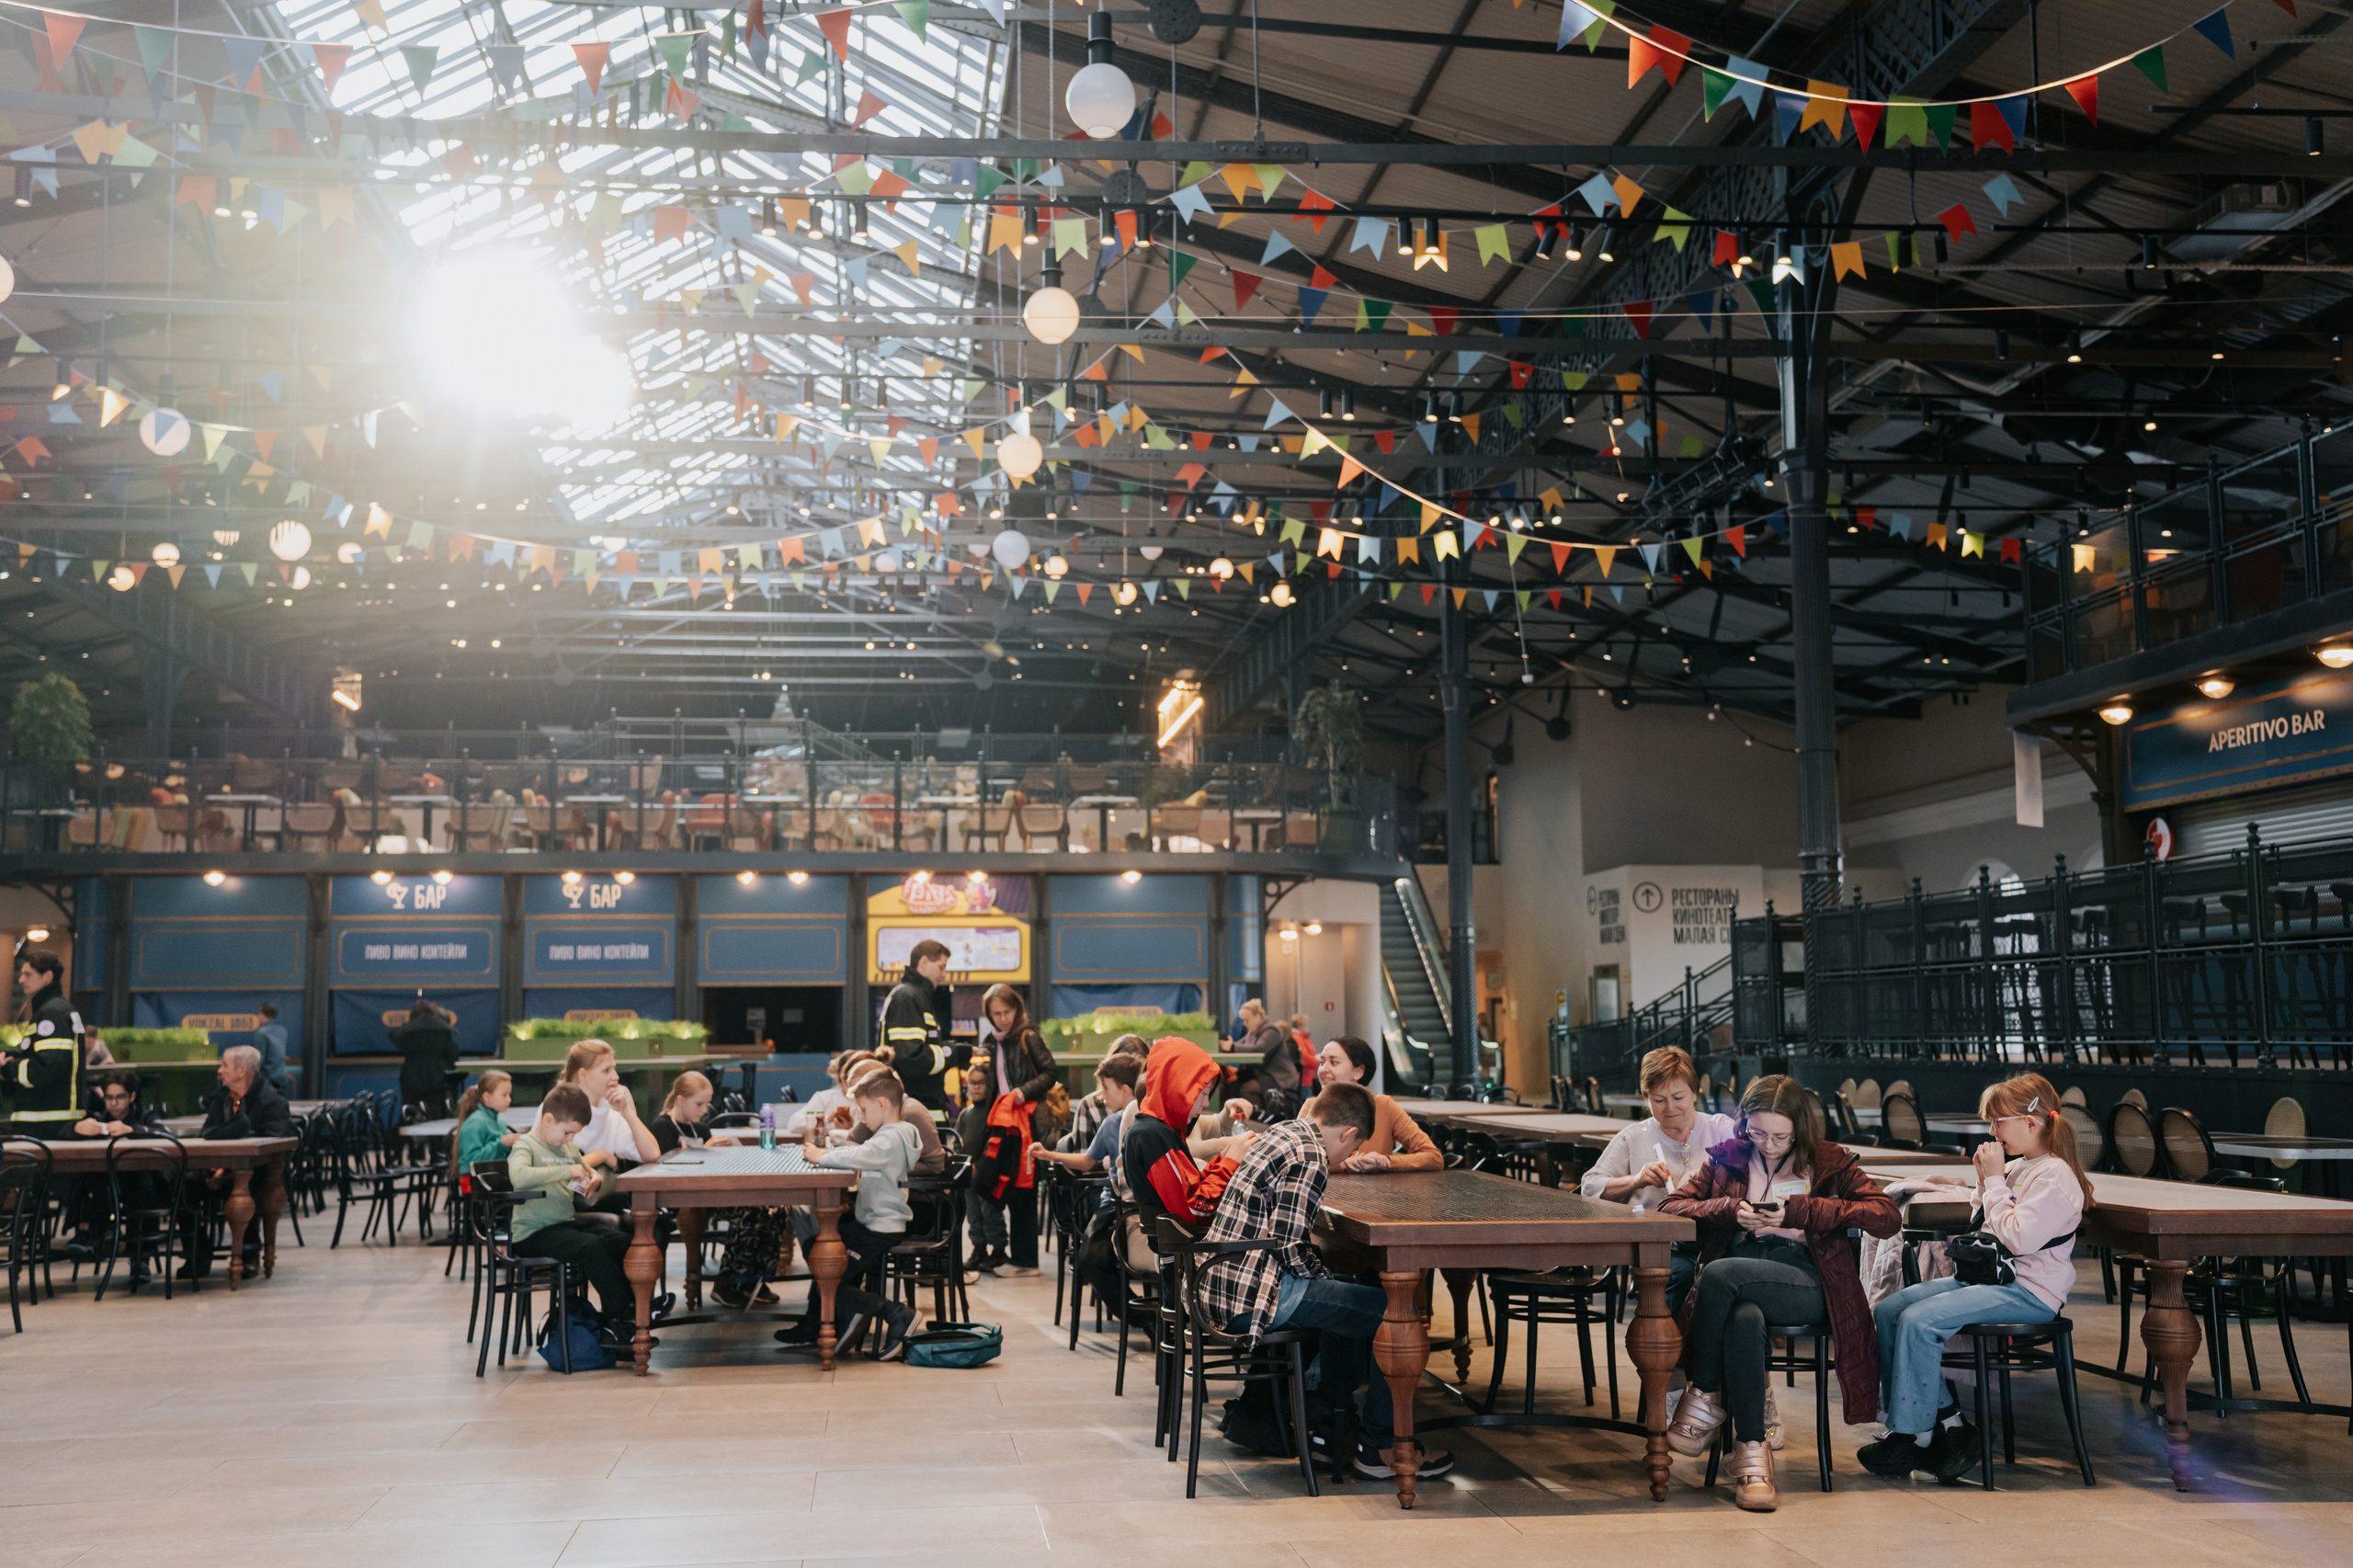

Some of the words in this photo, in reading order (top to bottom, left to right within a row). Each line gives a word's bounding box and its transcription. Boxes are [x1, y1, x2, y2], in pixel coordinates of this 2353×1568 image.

[2208, 716, 2289, 753] APERITIVO
[2291, 709, 2325, 735] BAR
[415, 884, 447, 909] БАР
[590, 884, 622, 908] БАР
[1671, 888, 1739, 906] РЕСТОРАНЫ
[1672, 907, 1730, 925] КИНОТЕАТ
[1673, 926, 1715, 944] МАЛАЯ
